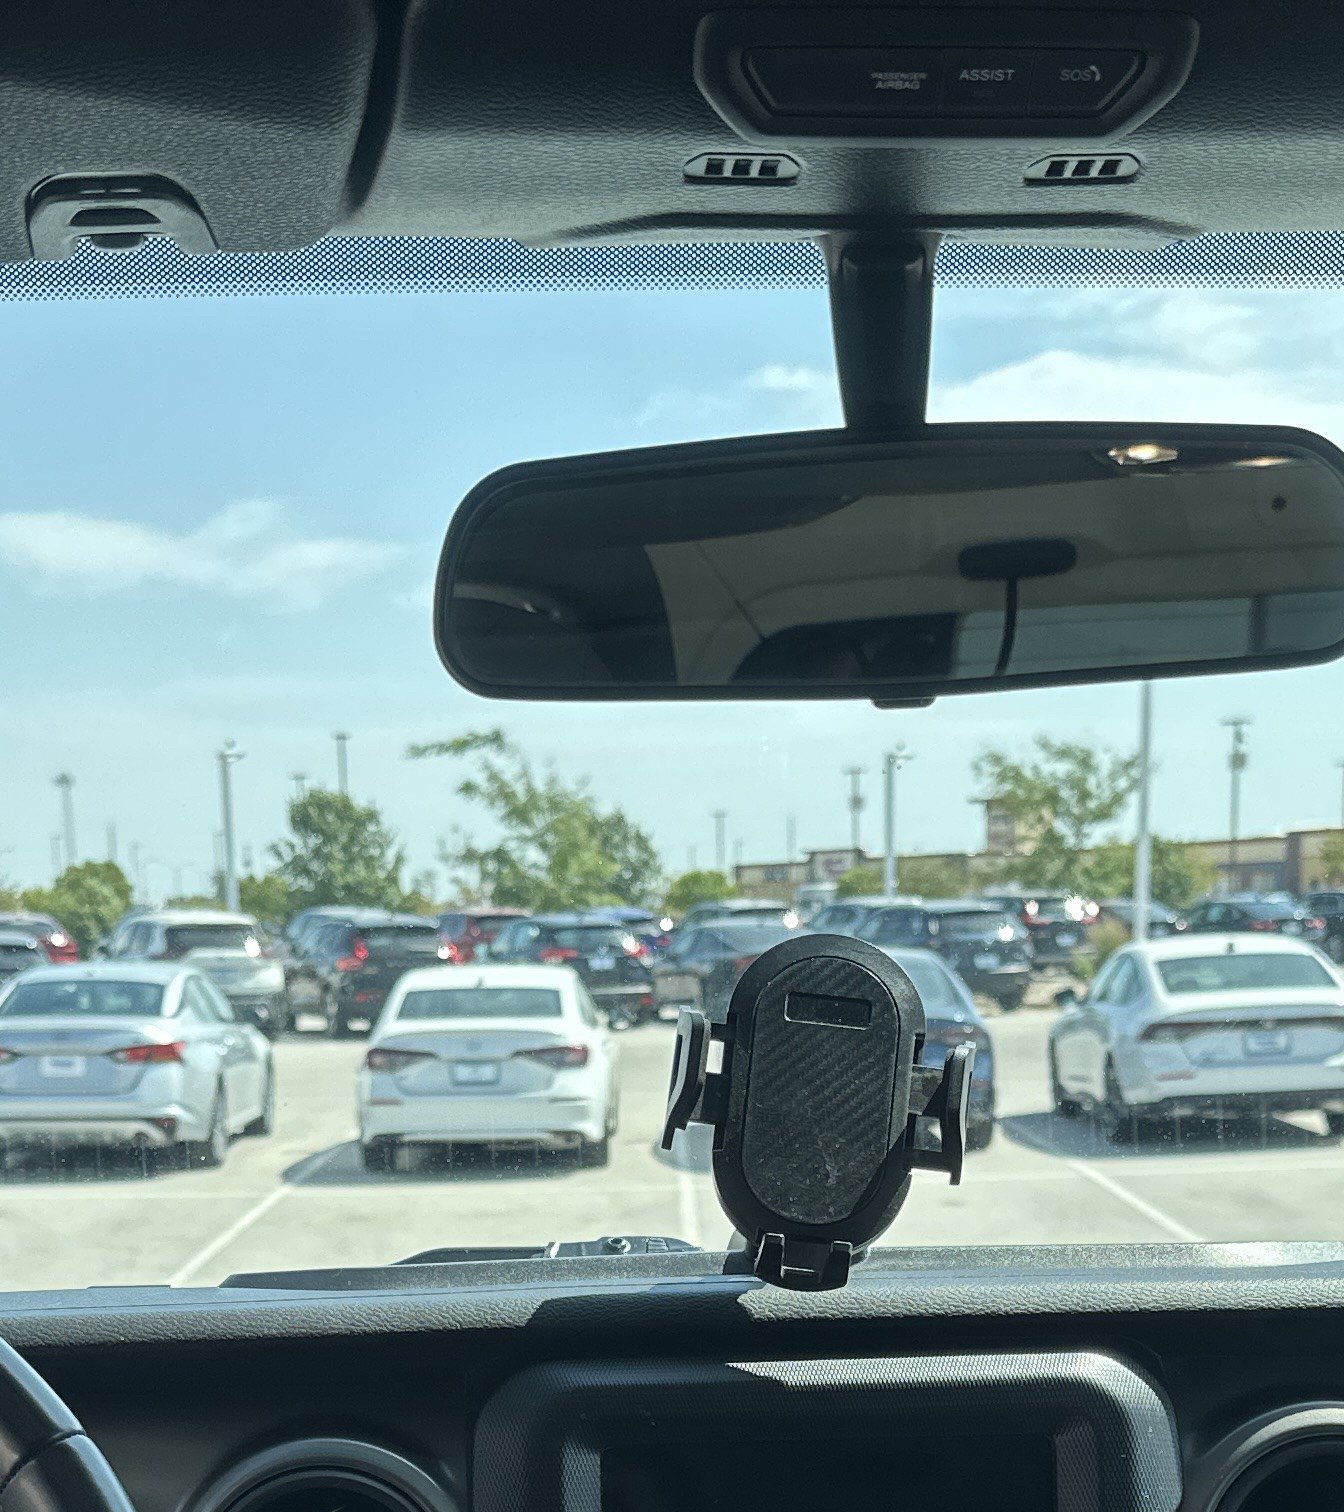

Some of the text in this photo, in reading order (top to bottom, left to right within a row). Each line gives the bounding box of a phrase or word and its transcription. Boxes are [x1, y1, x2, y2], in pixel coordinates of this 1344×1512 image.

[959, 69, 1016, 81] ASSIST
[1059, 69, 1092, 82] SOS
[874, 81, 920, 90] AIRBAG
